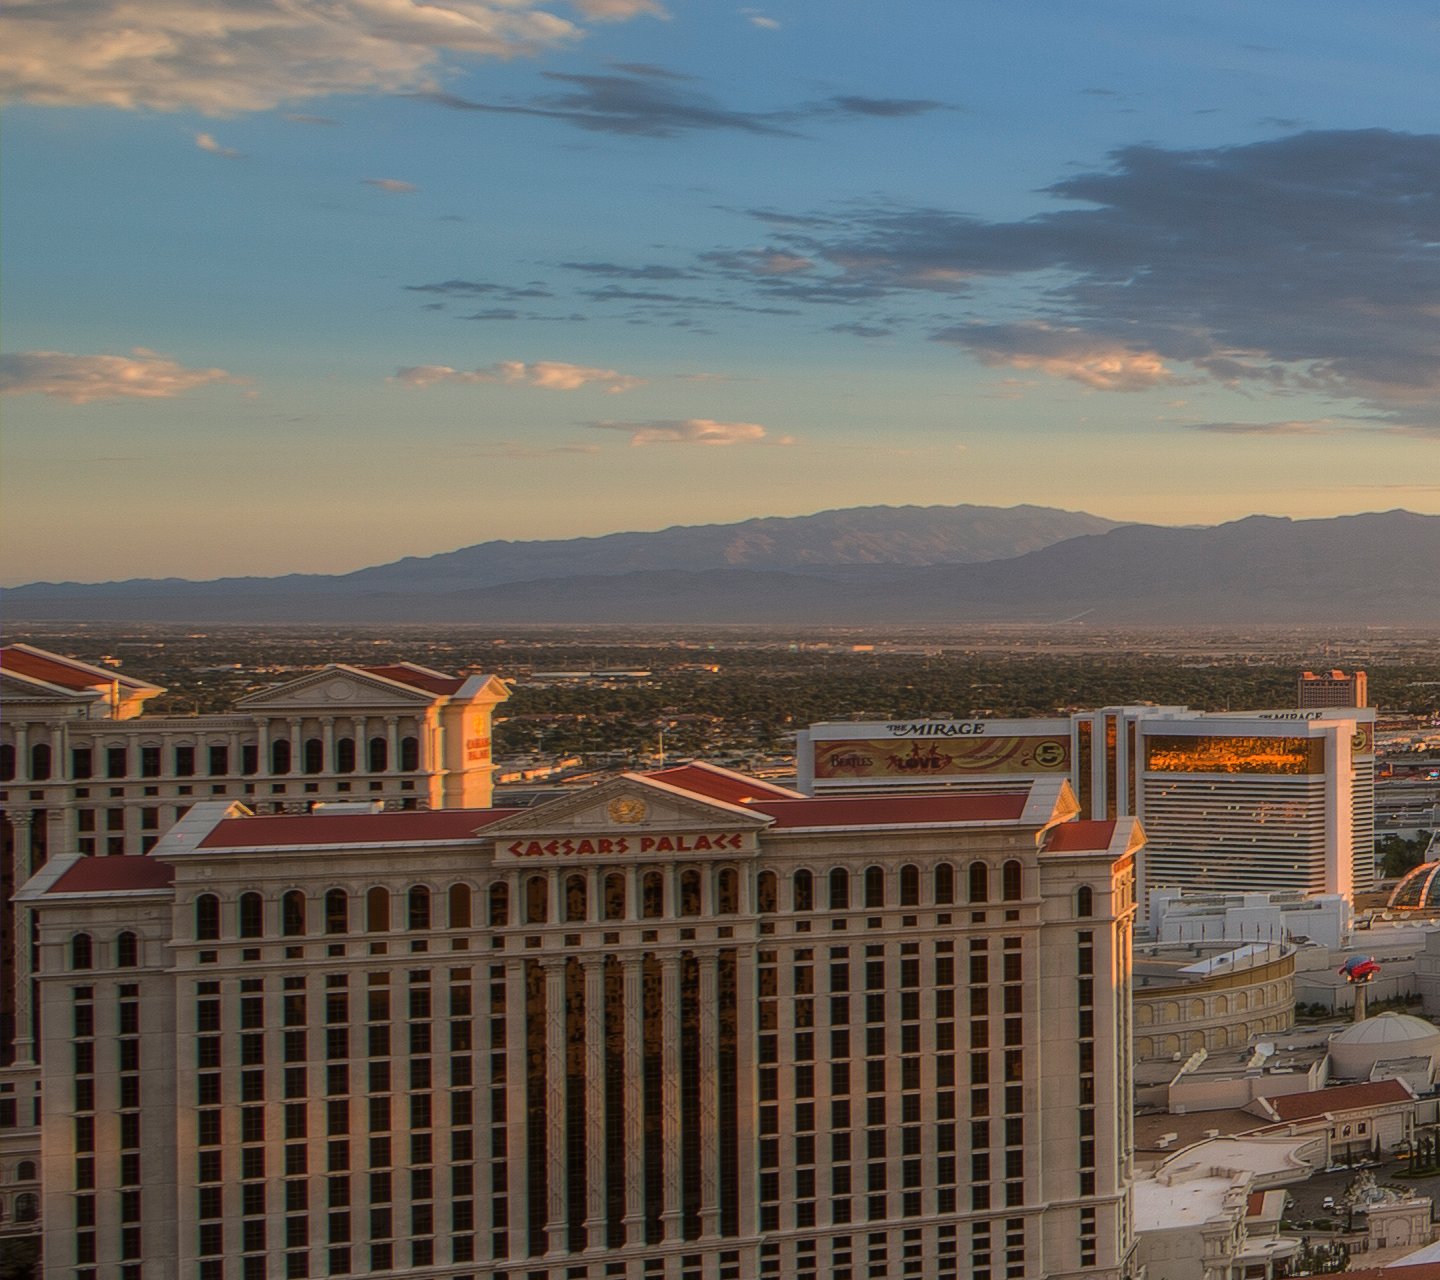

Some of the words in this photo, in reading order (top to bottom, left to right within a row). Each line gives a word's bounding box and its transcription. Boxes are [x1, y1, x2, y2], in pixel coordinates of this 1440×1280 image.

[894, 723, 985, 737] MIRAGE
[898, 756, 940, 769] LOVE
[507, 837, 630, 858] CAESARS
[640, 832, 743, 853] PALACE
